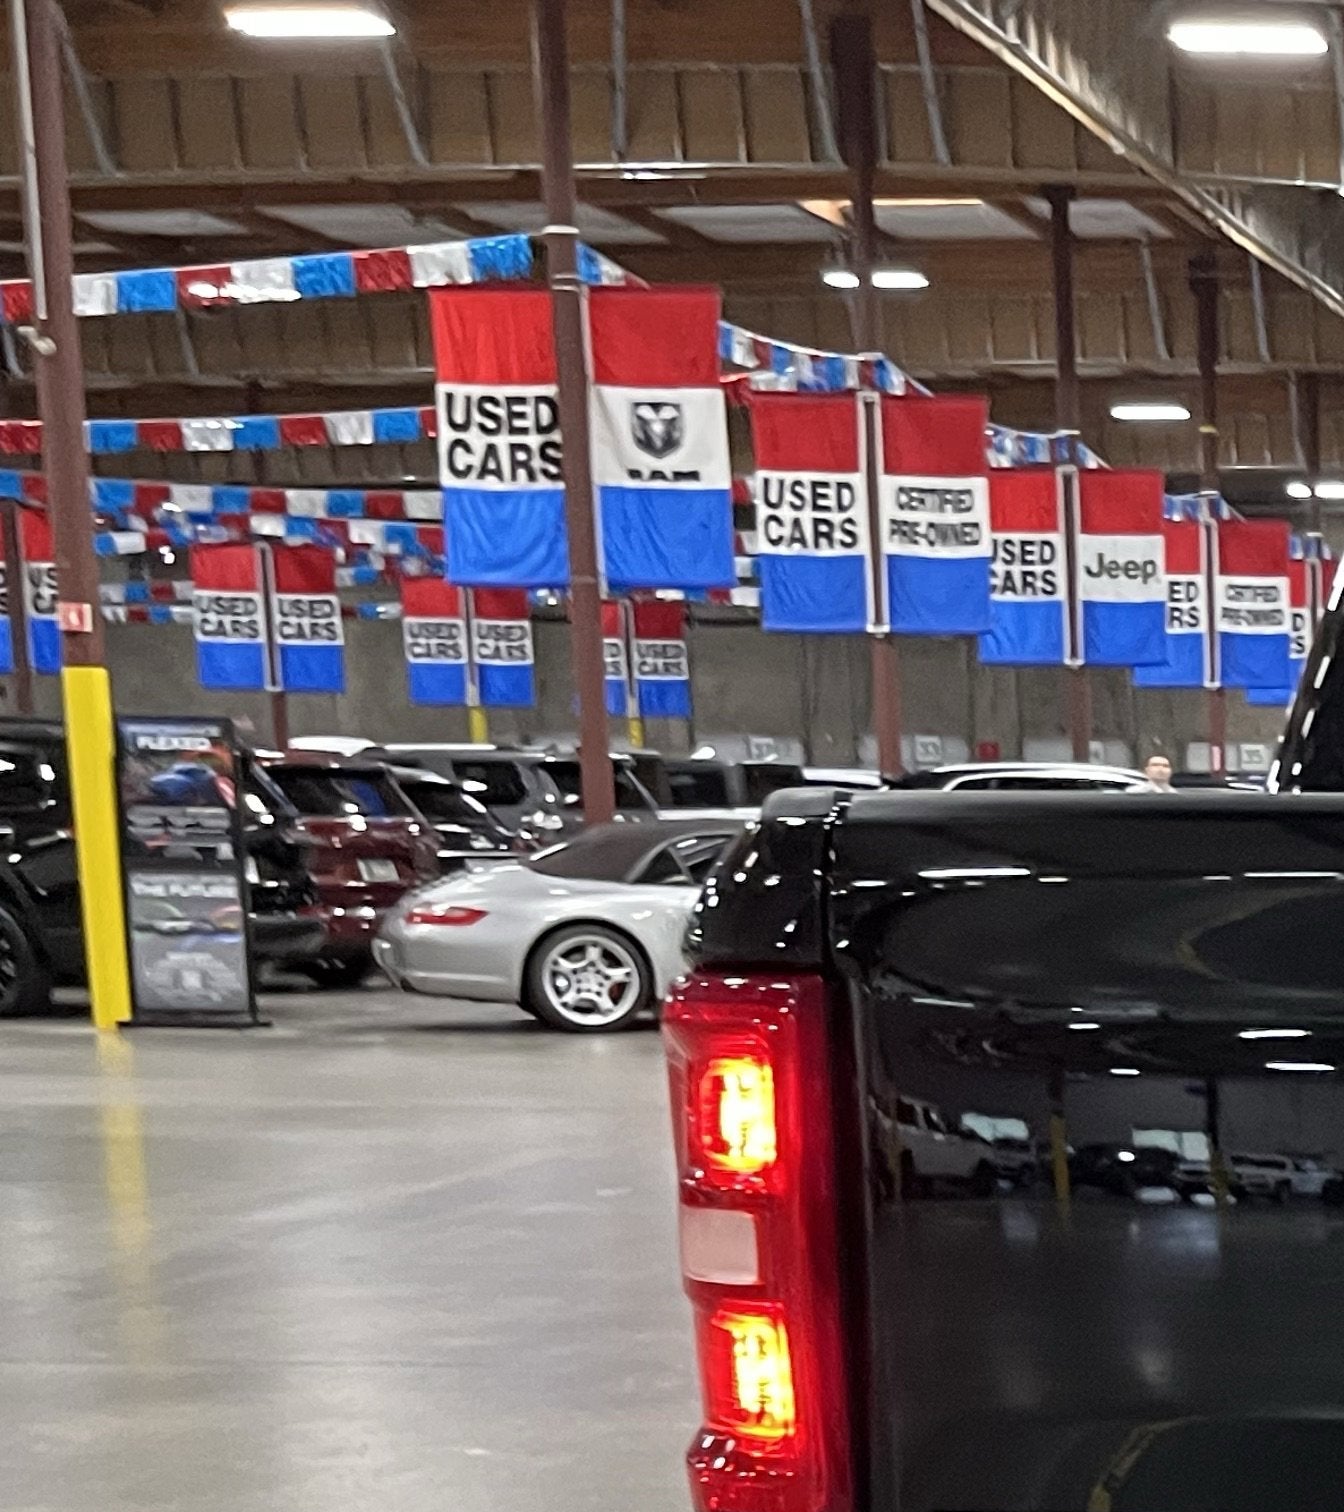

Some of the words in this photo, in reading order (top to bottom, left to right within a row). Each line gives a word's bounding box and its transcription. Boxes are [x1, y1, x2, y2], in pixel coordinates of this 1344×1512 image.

[446, 392, 558, 436] USED
[449, 438, 563, 482] CARS
[763, 478, 855, 513] USED
[763, 514, 858, 548] CARS
[1084, 553, 1157, 584] Jeep
